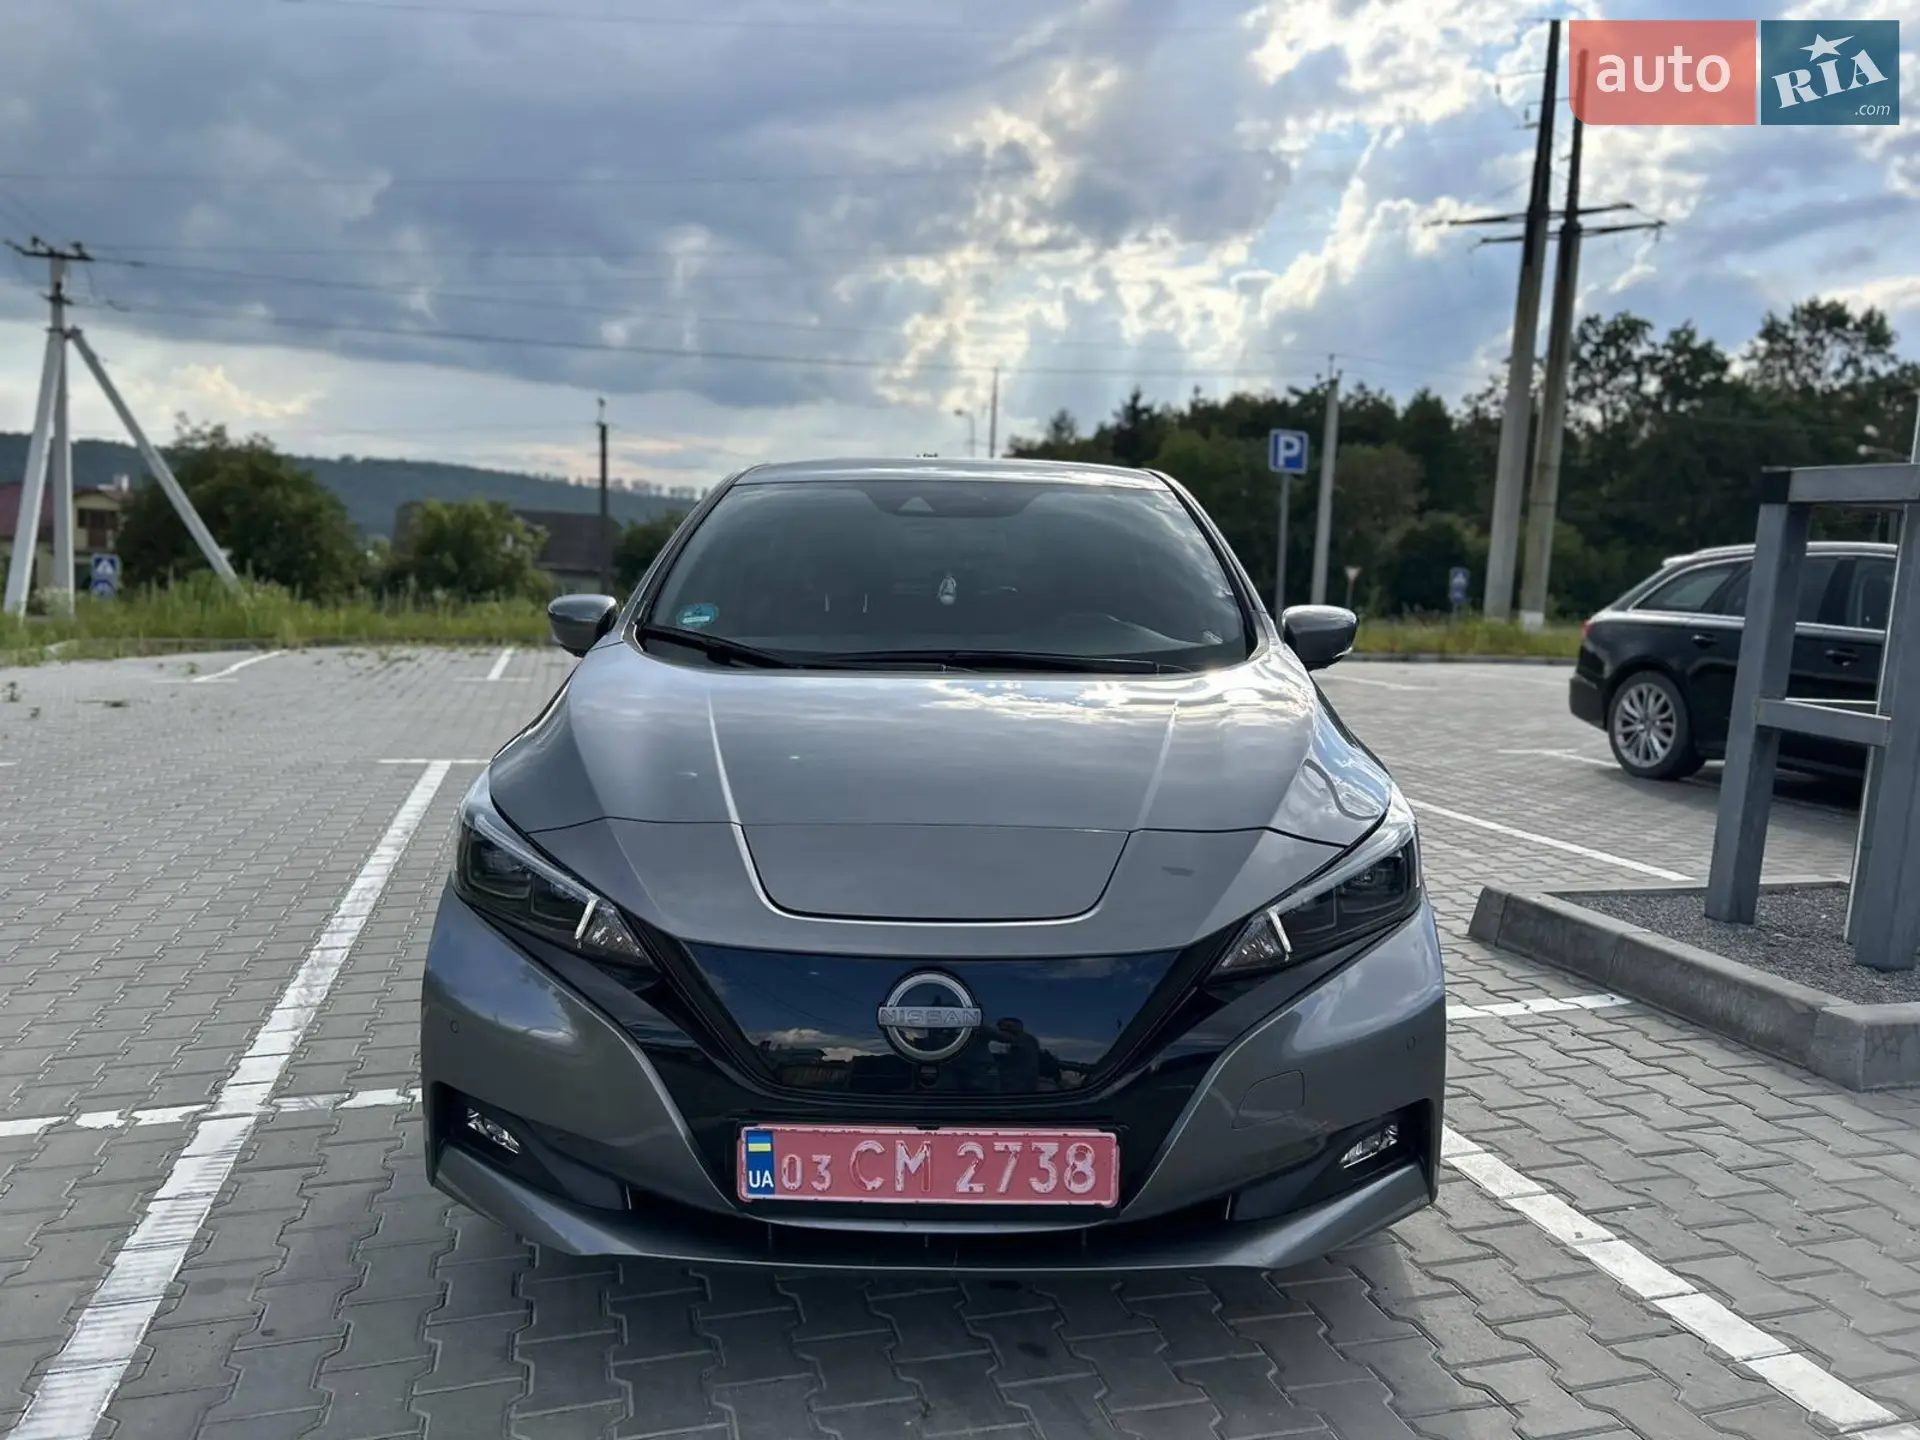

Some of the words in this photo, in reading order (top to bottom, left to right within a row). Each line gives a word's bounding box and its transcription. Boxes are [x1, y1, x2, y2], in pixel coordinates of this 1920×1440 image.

[1277, 434, 1300, 468] P
[880, 1008, 980, 1025] NISSAN
[749, 1170, 774, 1188] UA
[781, 1154, 833, 1192] 03
[848, 1139, 932, 1192] CM
[955, 1141, 1097, 1194] 2738
